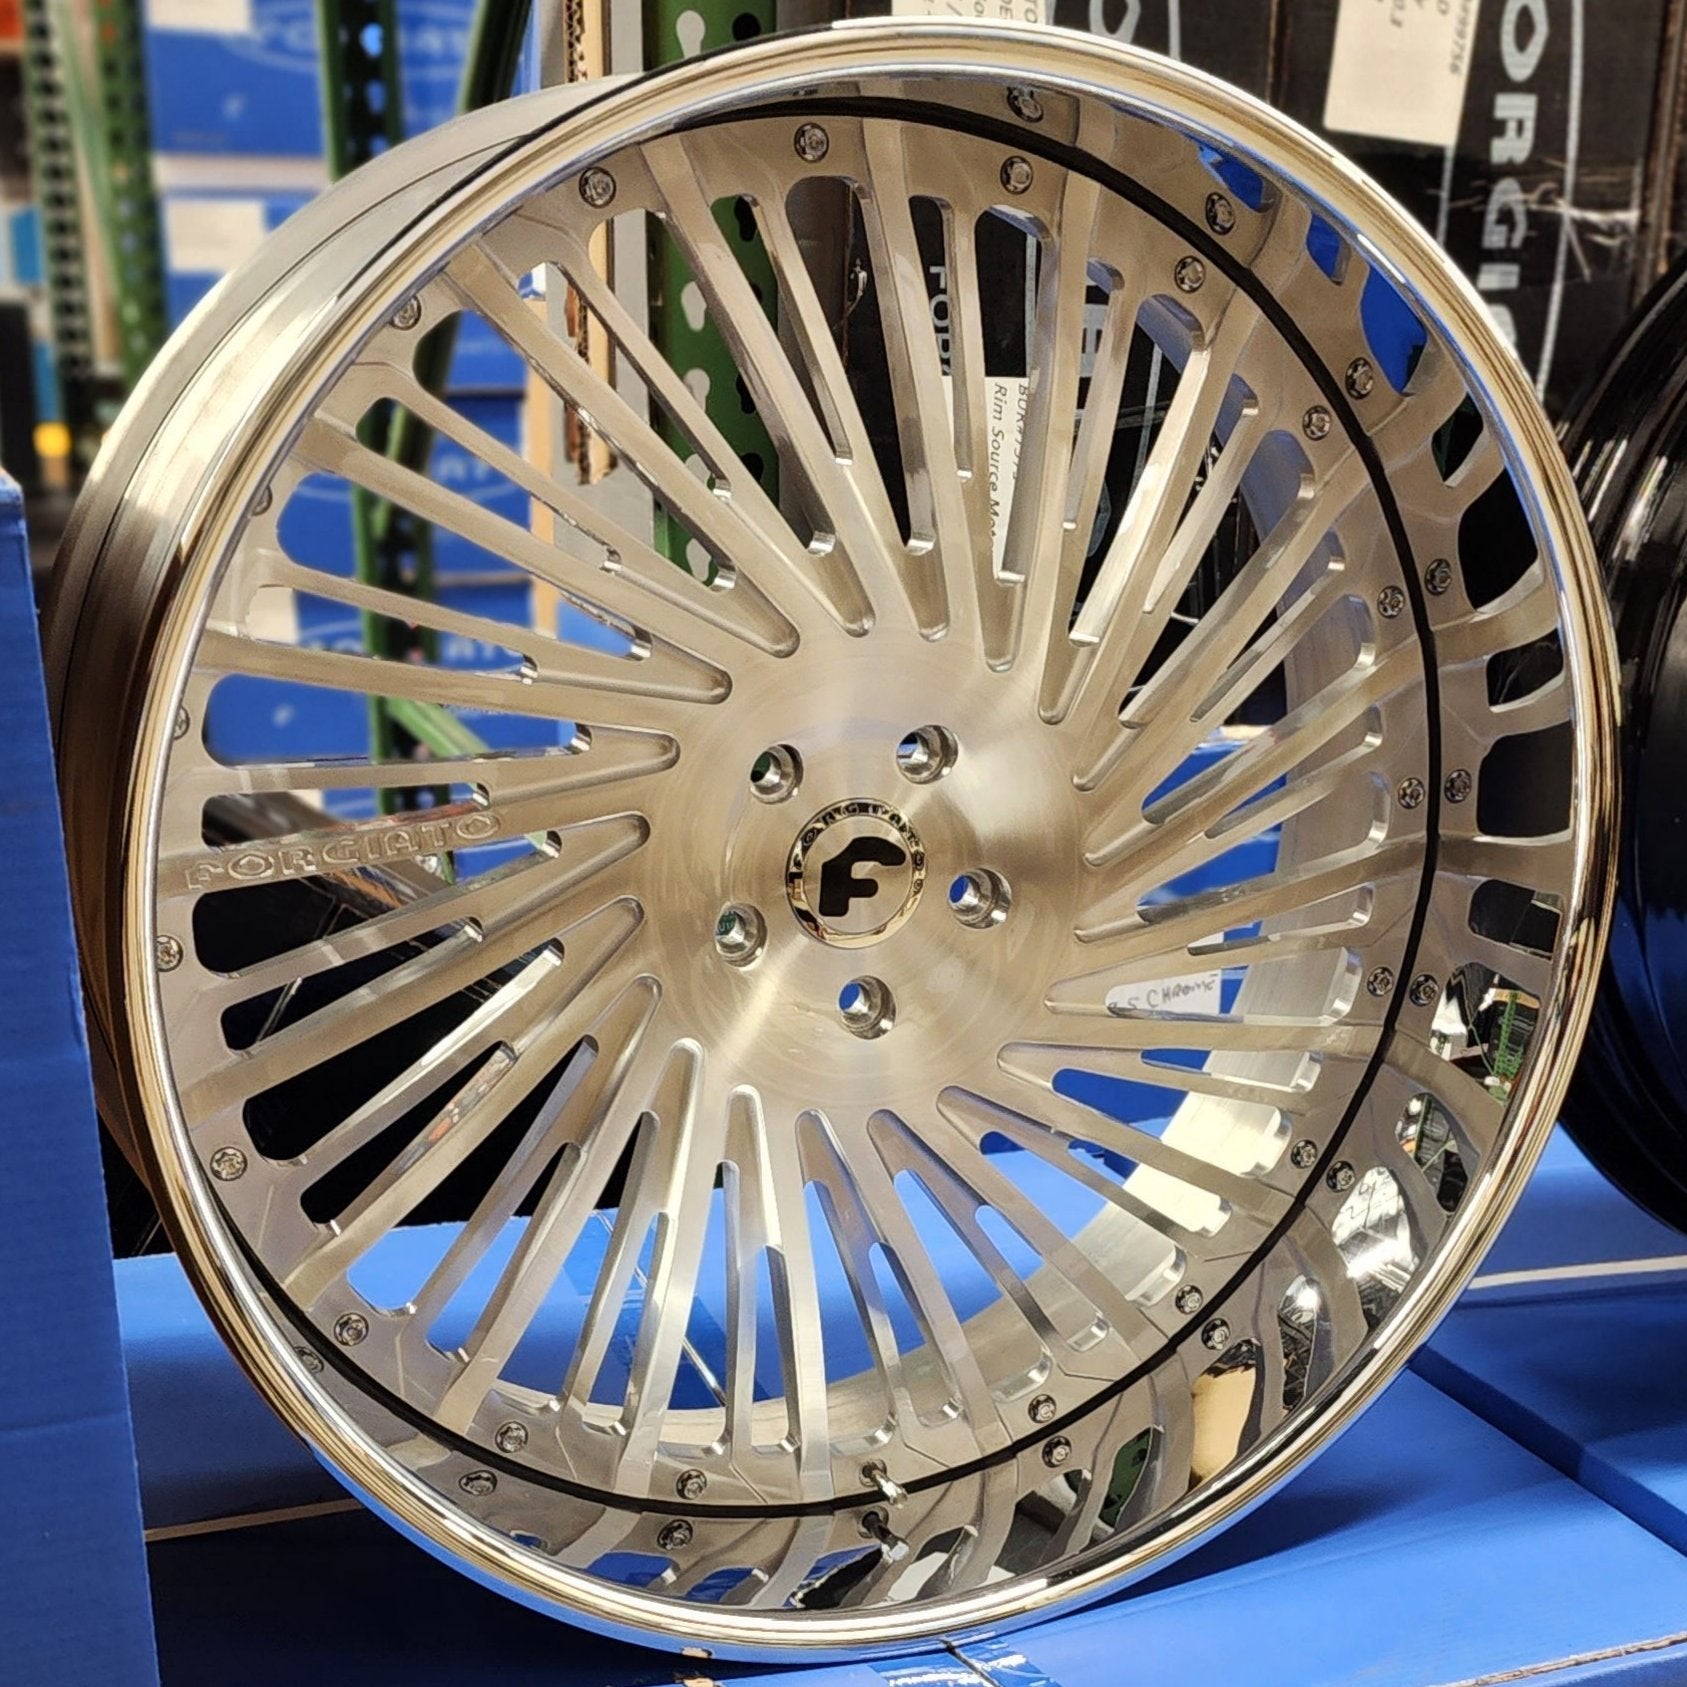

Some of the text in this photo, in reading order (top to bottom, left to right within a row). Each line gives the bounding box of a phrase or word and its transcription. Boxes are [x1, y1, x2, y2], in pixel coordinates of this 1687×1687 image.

[991, 382, 1008, 421] Rim
[988, 426, 1005, 492] Source
[185, 811, 500, 891] FORGIATO
